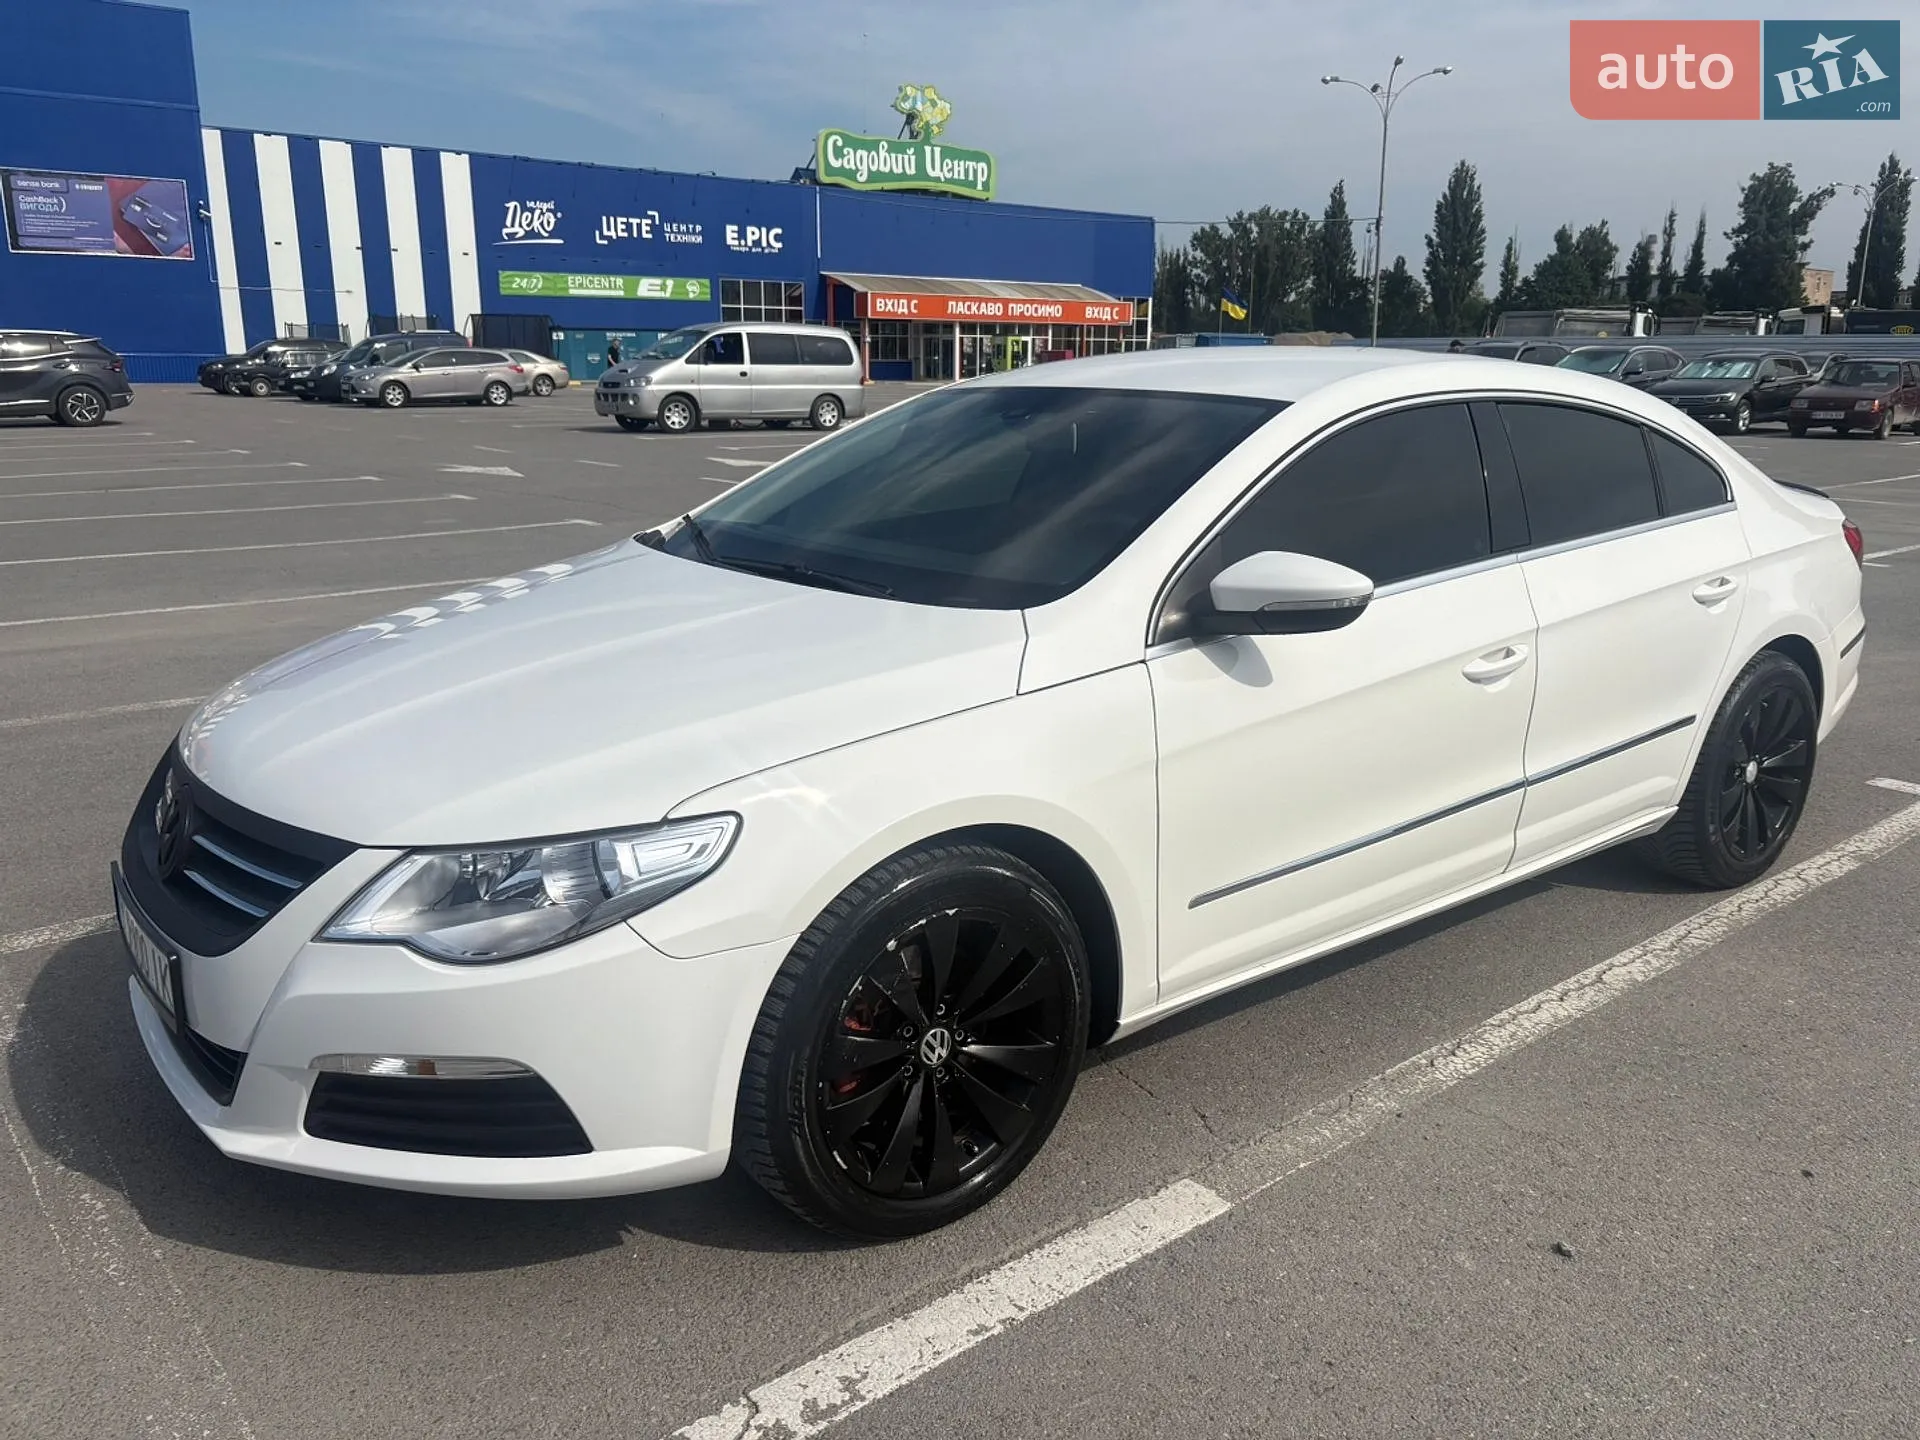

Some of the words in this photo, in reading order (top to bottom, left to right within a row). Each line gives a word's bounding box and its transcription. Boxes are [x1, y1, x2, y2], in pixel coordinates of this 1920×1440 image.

[827, 134, 916, 183] Садовий
[924, 145, 989, 190] Центр
[502, 201, 557, 240] Деко
[602, 215, 653, 239] ЦЕТЕ
[663, 222, 702, 233] ЦЕНТР
[726, 224, 783, 248] E.PIC
[567, 275, 624, 289] EPICENTR
[876, 298, 908, 314] ВХІД
[947, 300, 1003, 317] ЛАСКАВО
[1008, 303, 1062, 318] ПРОСИМО
[1085, 306, 1111, 320] ВХІД
